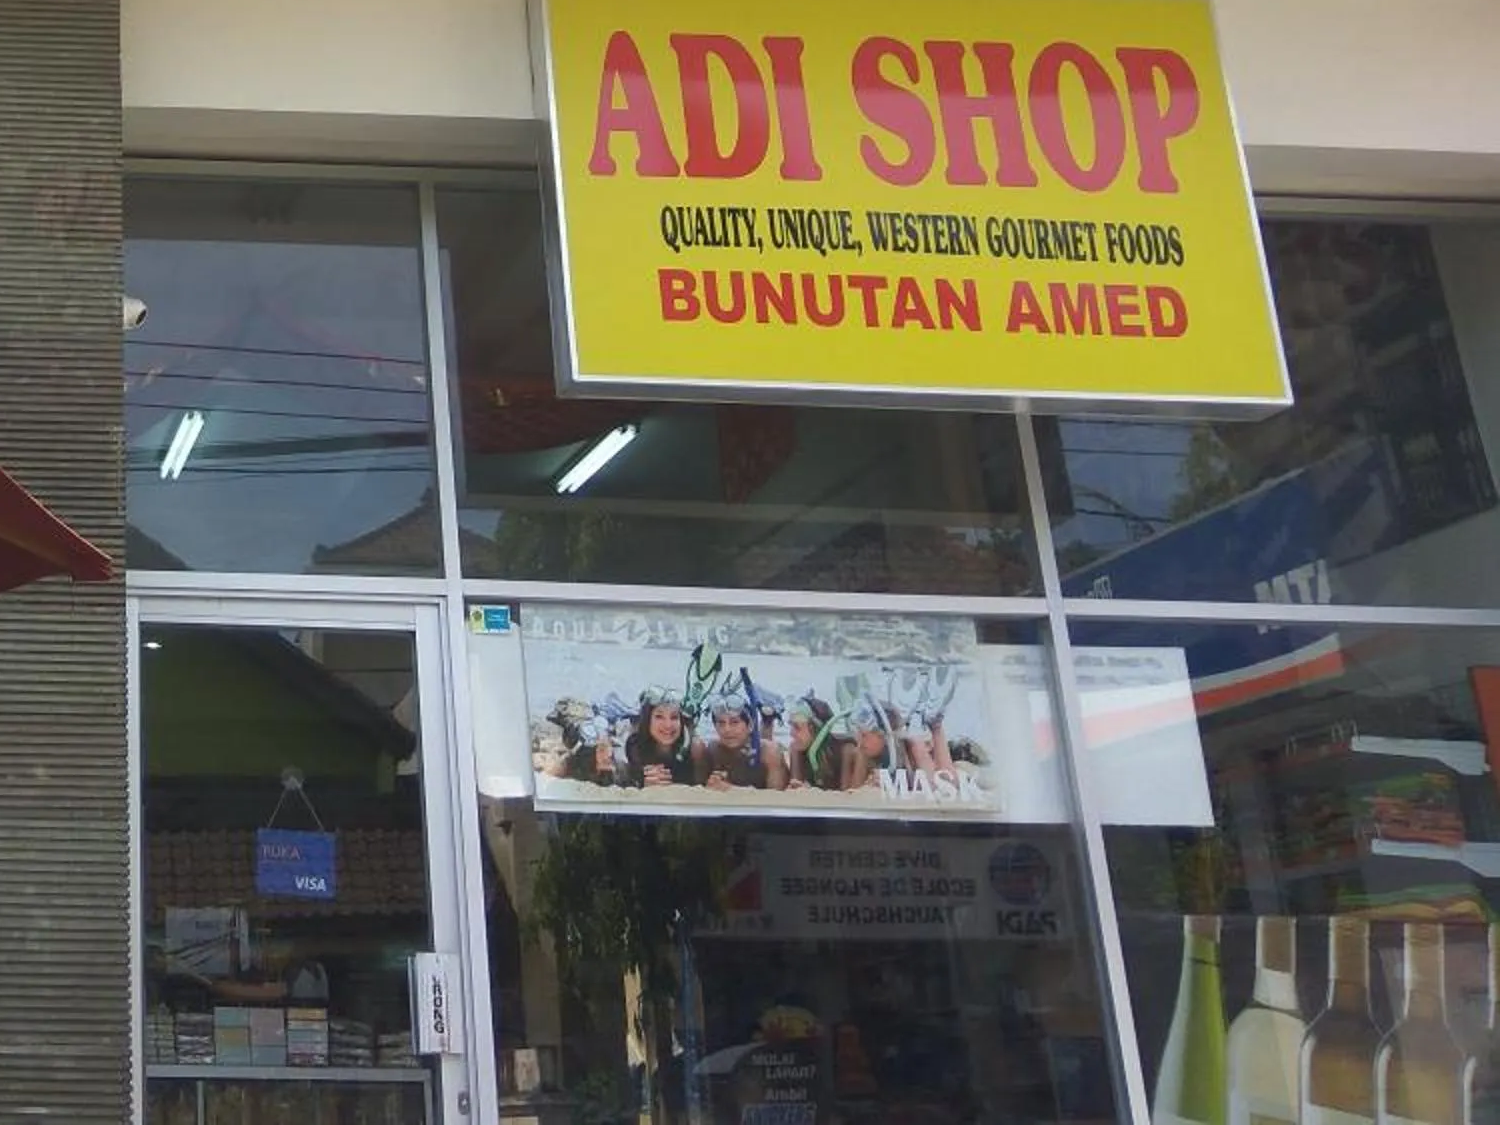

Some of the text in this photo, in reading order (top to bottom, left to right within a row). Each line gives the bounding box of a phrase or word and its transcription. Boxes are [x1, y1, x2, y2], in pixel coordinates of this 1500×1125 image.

[588, 30, 1200, 194] ADI SHOP
[660, 205, 1185, 267] QUALITY, UNIQUE, WESTERN GOURMET FOODS
[657, 268, 1189, 338] BUNUTAN AMED
[879, 768, 984, 801] MASK
[293, 875, 327, 892] VISA
